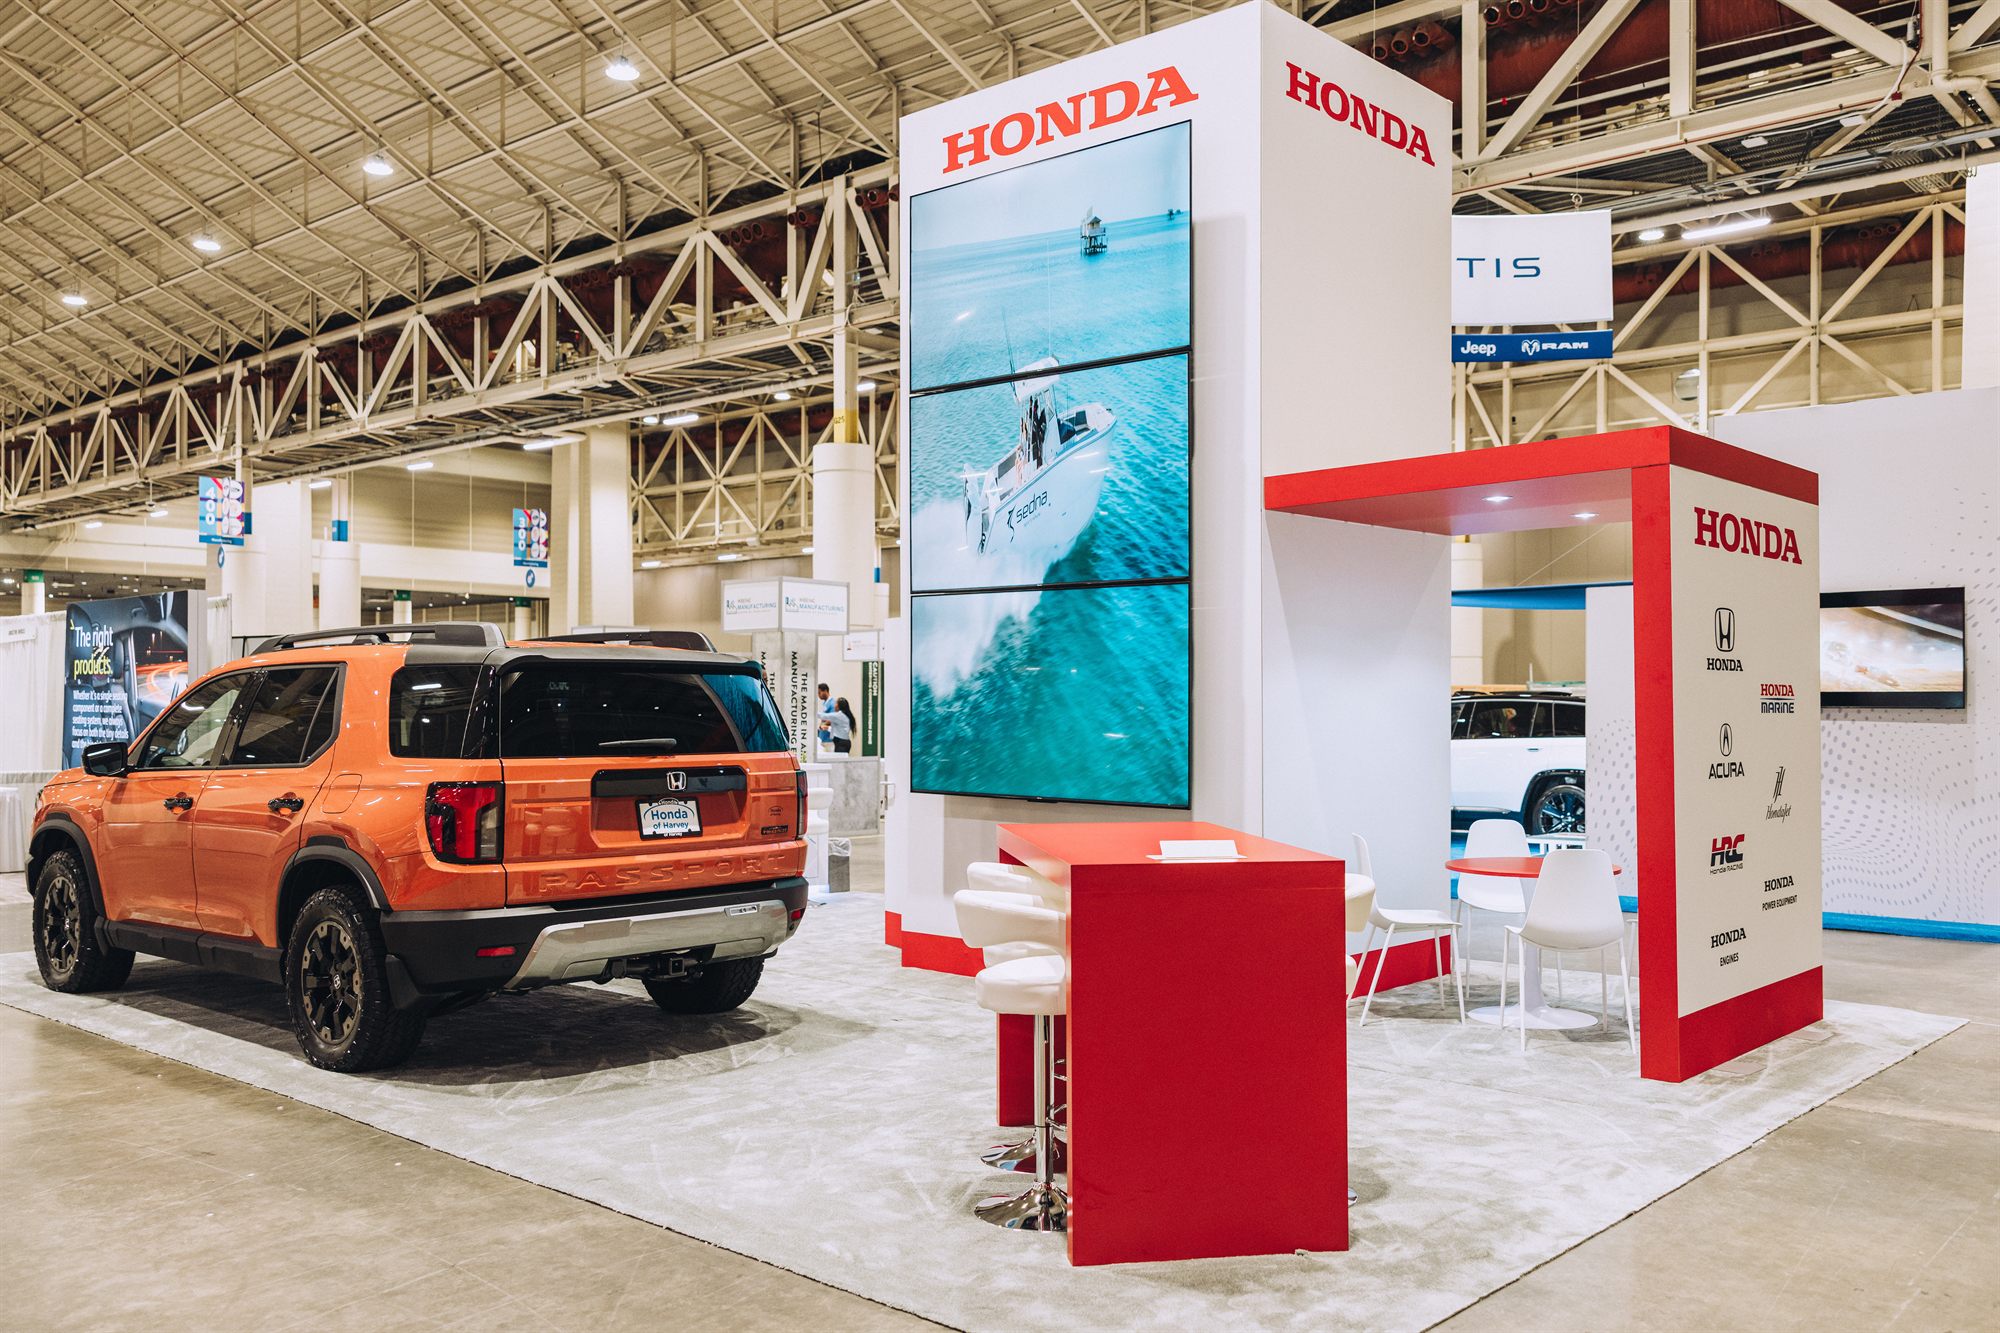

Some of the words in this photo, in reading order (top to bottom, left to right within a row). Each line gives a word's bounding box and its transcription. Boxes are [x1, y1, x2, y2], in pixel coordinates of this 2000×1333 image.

[943, 65, 1198, 174] HONDA
[1286, 60, 1435, 167] HONDA
[1456, 257, 1541, 278] TIS
[1461, 340, 1496, 356] Jeep
[1542, 342, 1589, 350] RAM
[1016, 491, 1047, 524] sedna
[1694, 506, 1802, 565] HONDA
[74, 626, 91, 647] The
[92, 624, 113, 652] right
[74, 654, 113, 680] products.
[1706, 657, 1743, 672] HONDA
[1760, 683, 1795, 697] HONDA
[801, 728, 807, 739] IN
[1708, 762, 1745, 780] ACURA
[651, 809, 688, 820] Honda
[663, 821, 689, 829] Harvey
[539, 854, 785, 892] PASSPORT
[1710, 866, 1726, 875] Honda
[1727, 863, 1744, 873] RACING
[1764, 876, 1794, 892] HONDA
[1762, 900, 1776, 911] POWER
[1776, 895, 1798, 908] EQUIPMENT
[1710, 928, 1746, 948] HONDA
[1720, 953, 1739, 967] ENGINES
